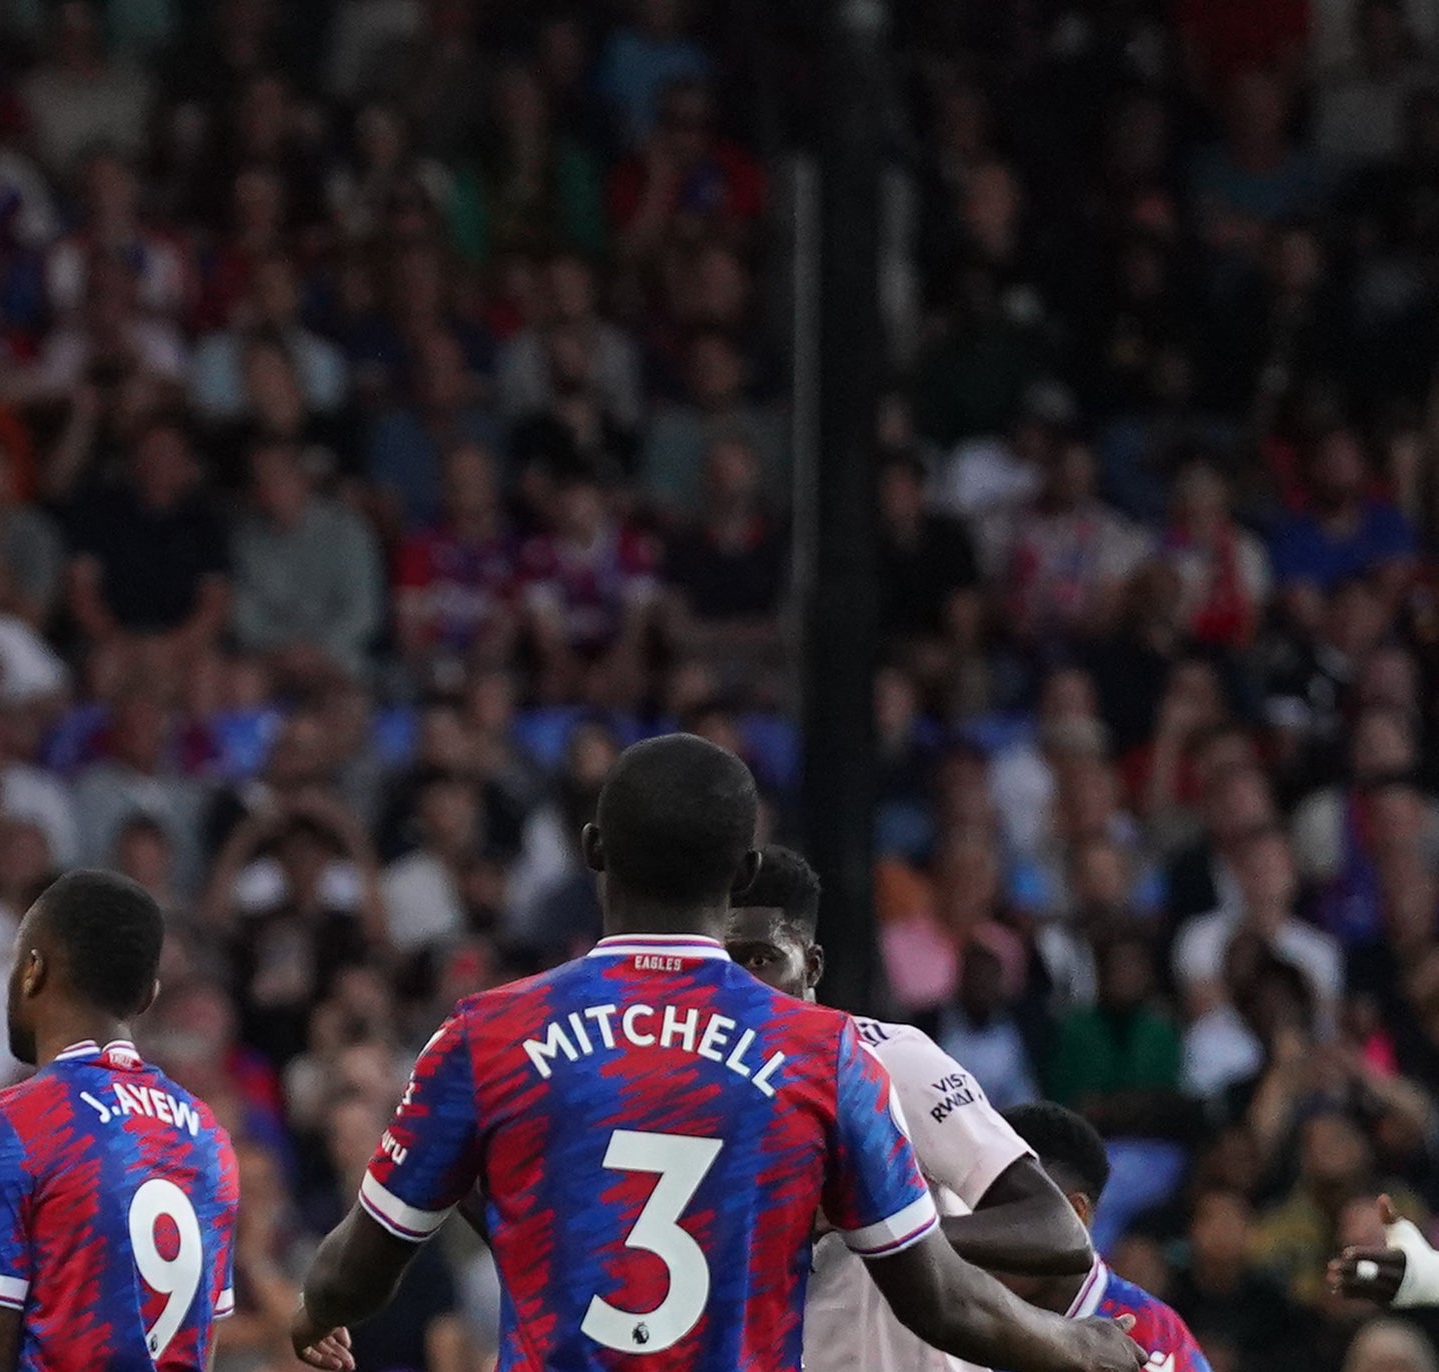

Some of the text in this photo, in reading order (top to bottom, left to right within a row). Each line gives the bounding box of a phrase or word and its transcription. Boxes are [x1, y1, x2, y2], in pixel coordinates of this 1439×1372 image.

[634, 955, 682, 971] EAGLES
[522, 1004, 786, 1098] MITCHELL
[80, 1083, 200, 1136] J.AYEW
[129, 1178, 203, 1361] 9
[580, 1129, 723, 1355] 3
